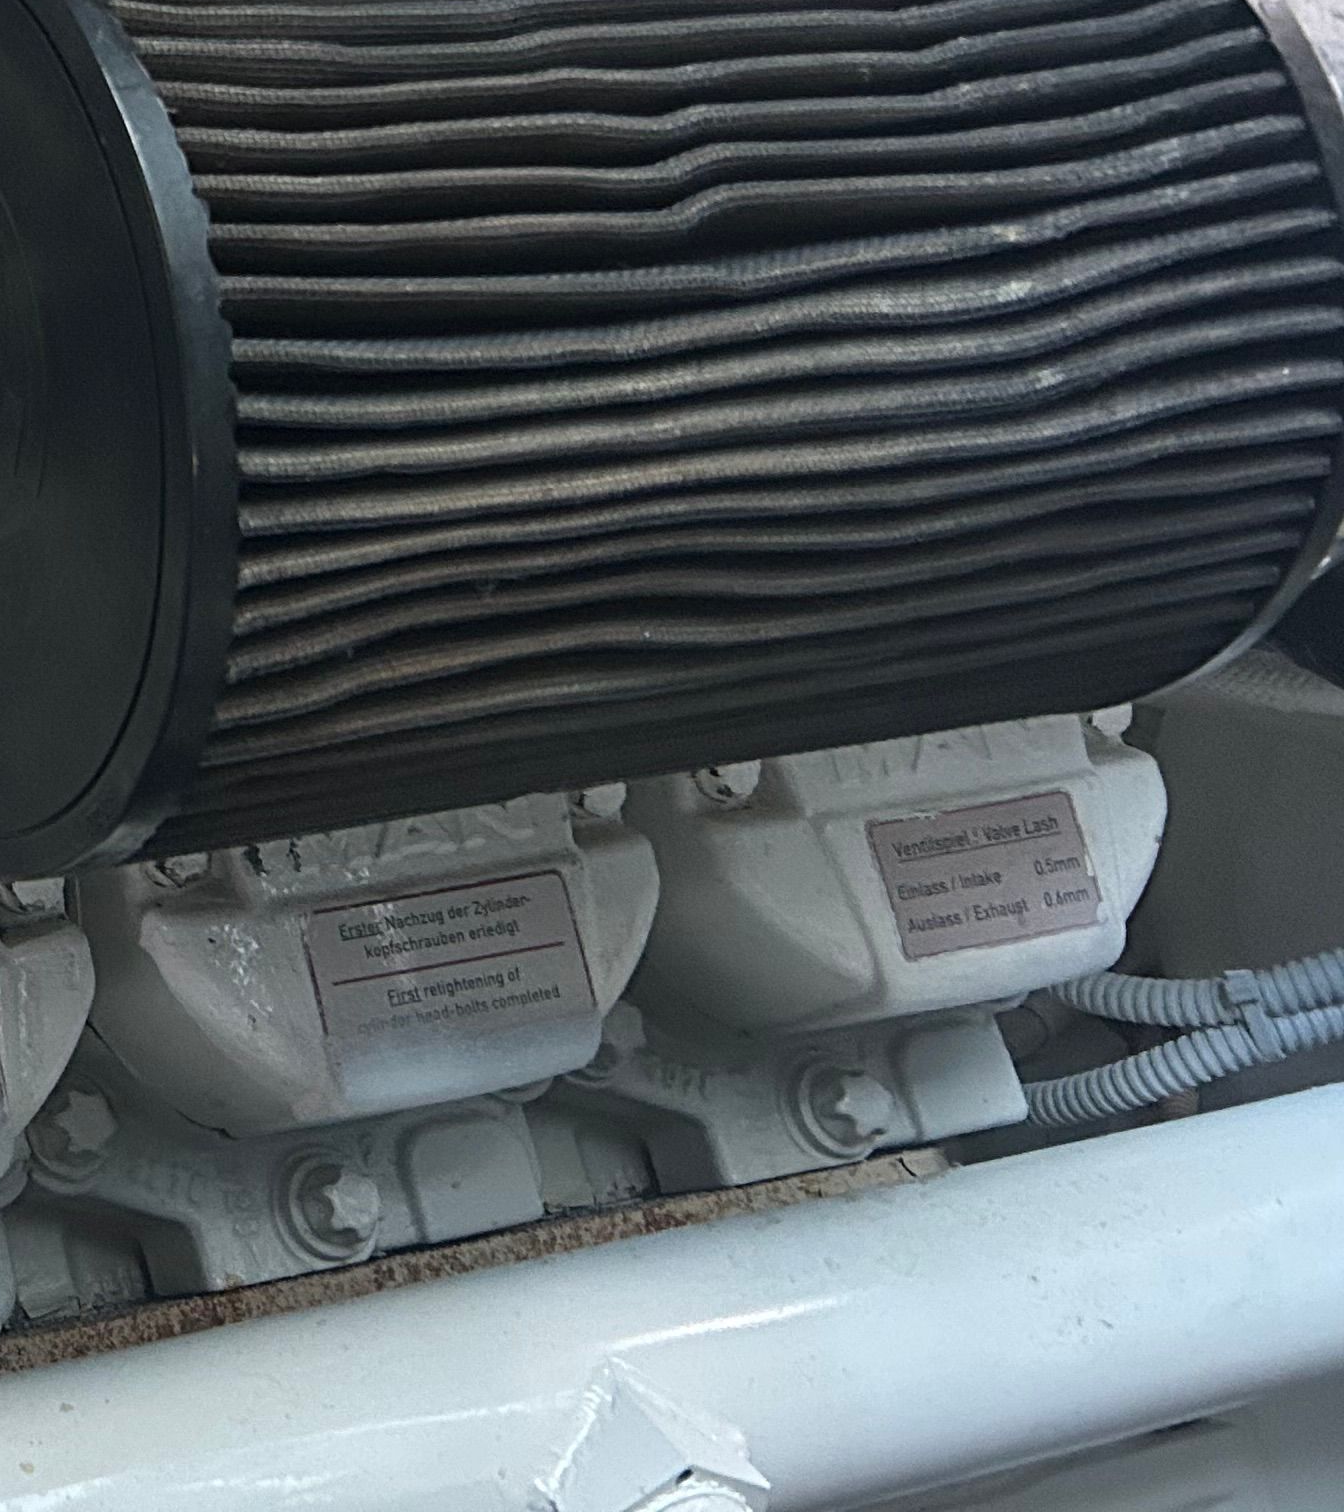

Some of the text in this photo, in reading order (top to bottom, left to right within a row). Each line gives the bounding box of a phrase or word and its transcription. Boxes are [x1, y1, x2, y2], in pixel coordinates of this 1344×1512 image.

[1023, 815, 1059, 835] Lash
[959, 870, 1002, 889] Intake
[338, 920, 384, 941] Erster
[384, 907, 445, 932] Nachzug
[448, 904, 470, 921] der
[907, 912, 961, 934] Auslass
[973, 898, 1029, 922] Exhaust
[364, 919, 520, 959] kopfschrauben erledigt
[387, 966, 521, 1007] First retightening of
[491, 984, 561, 1012] completed
